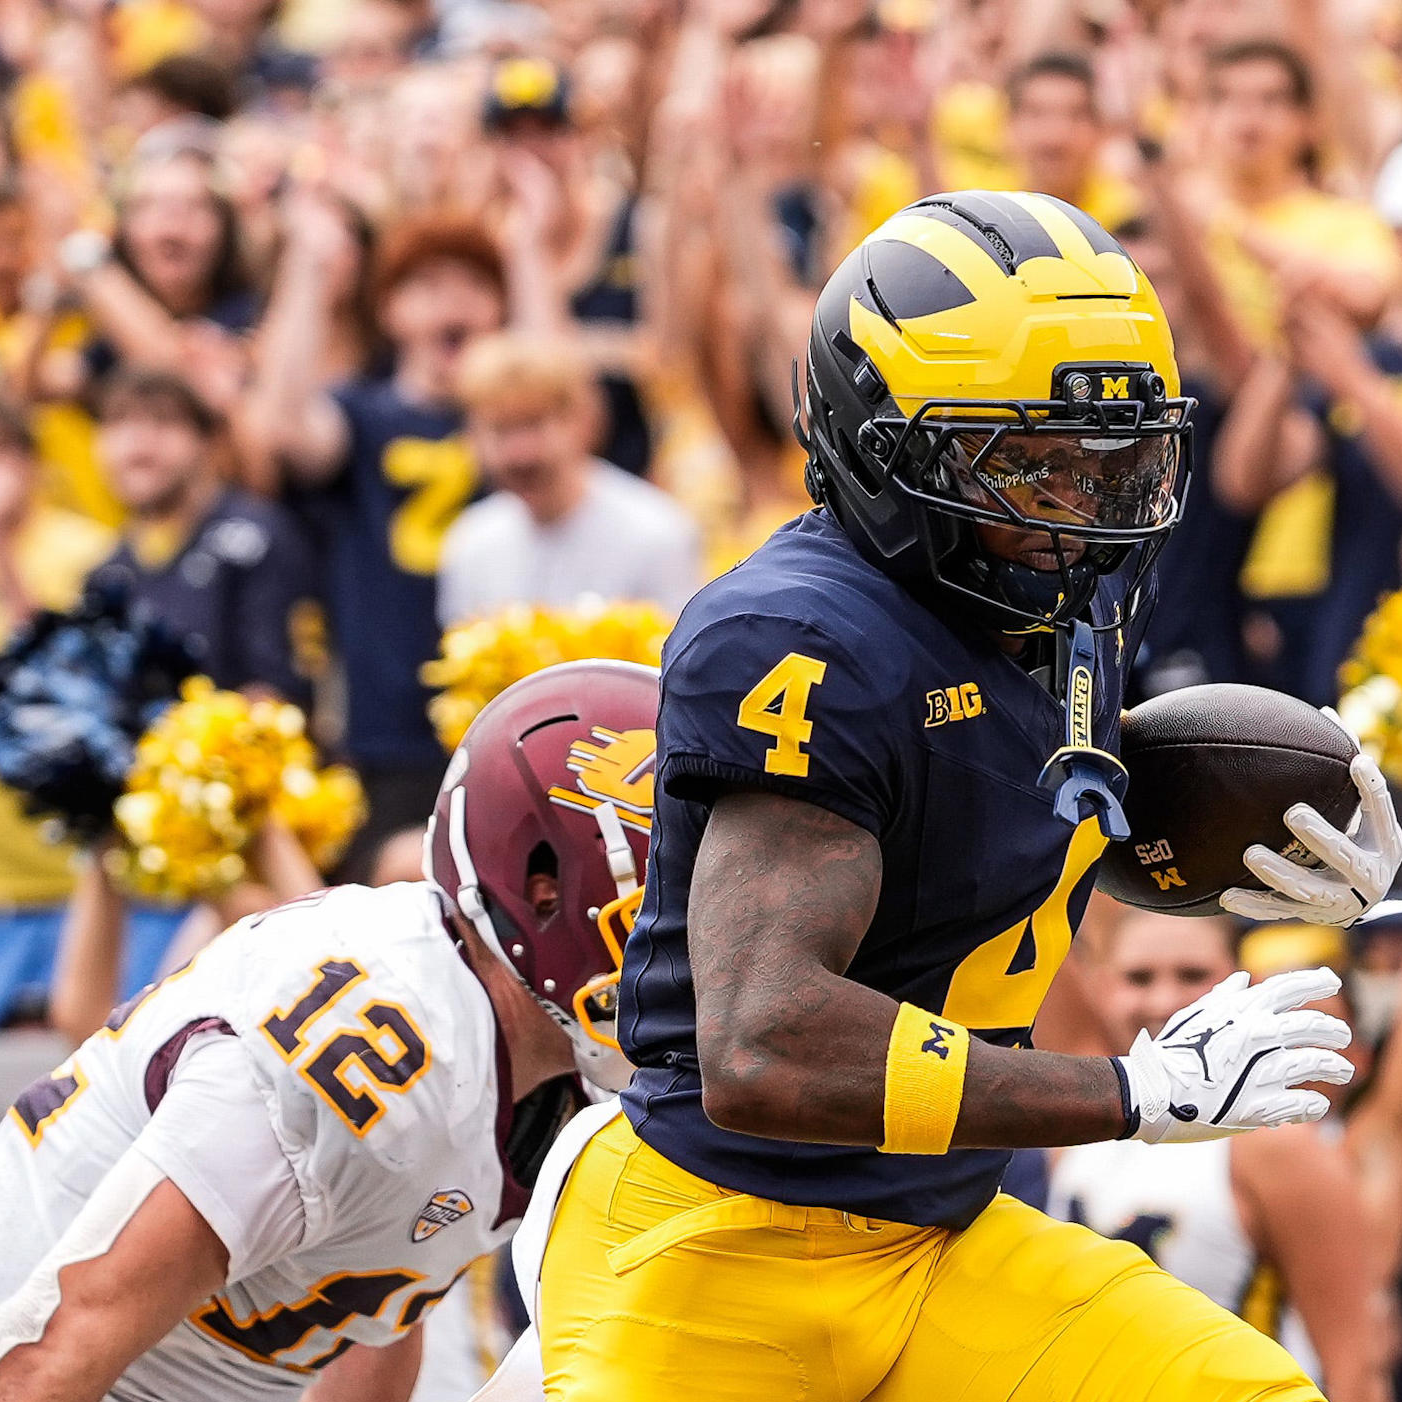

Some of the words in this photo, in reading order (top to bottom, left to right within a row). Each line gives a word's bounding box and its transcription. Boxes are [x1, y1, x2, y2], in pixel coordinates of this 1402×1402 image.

[1101, 376, 1130, 399] M
[737, 652, 827, 777] 4
[1150, 867, 1188, 891] M
[941, 814, 1111, 1046] 4
[260, 957, 431, 1138] 12
[921, 1021, 956, 1061] M
